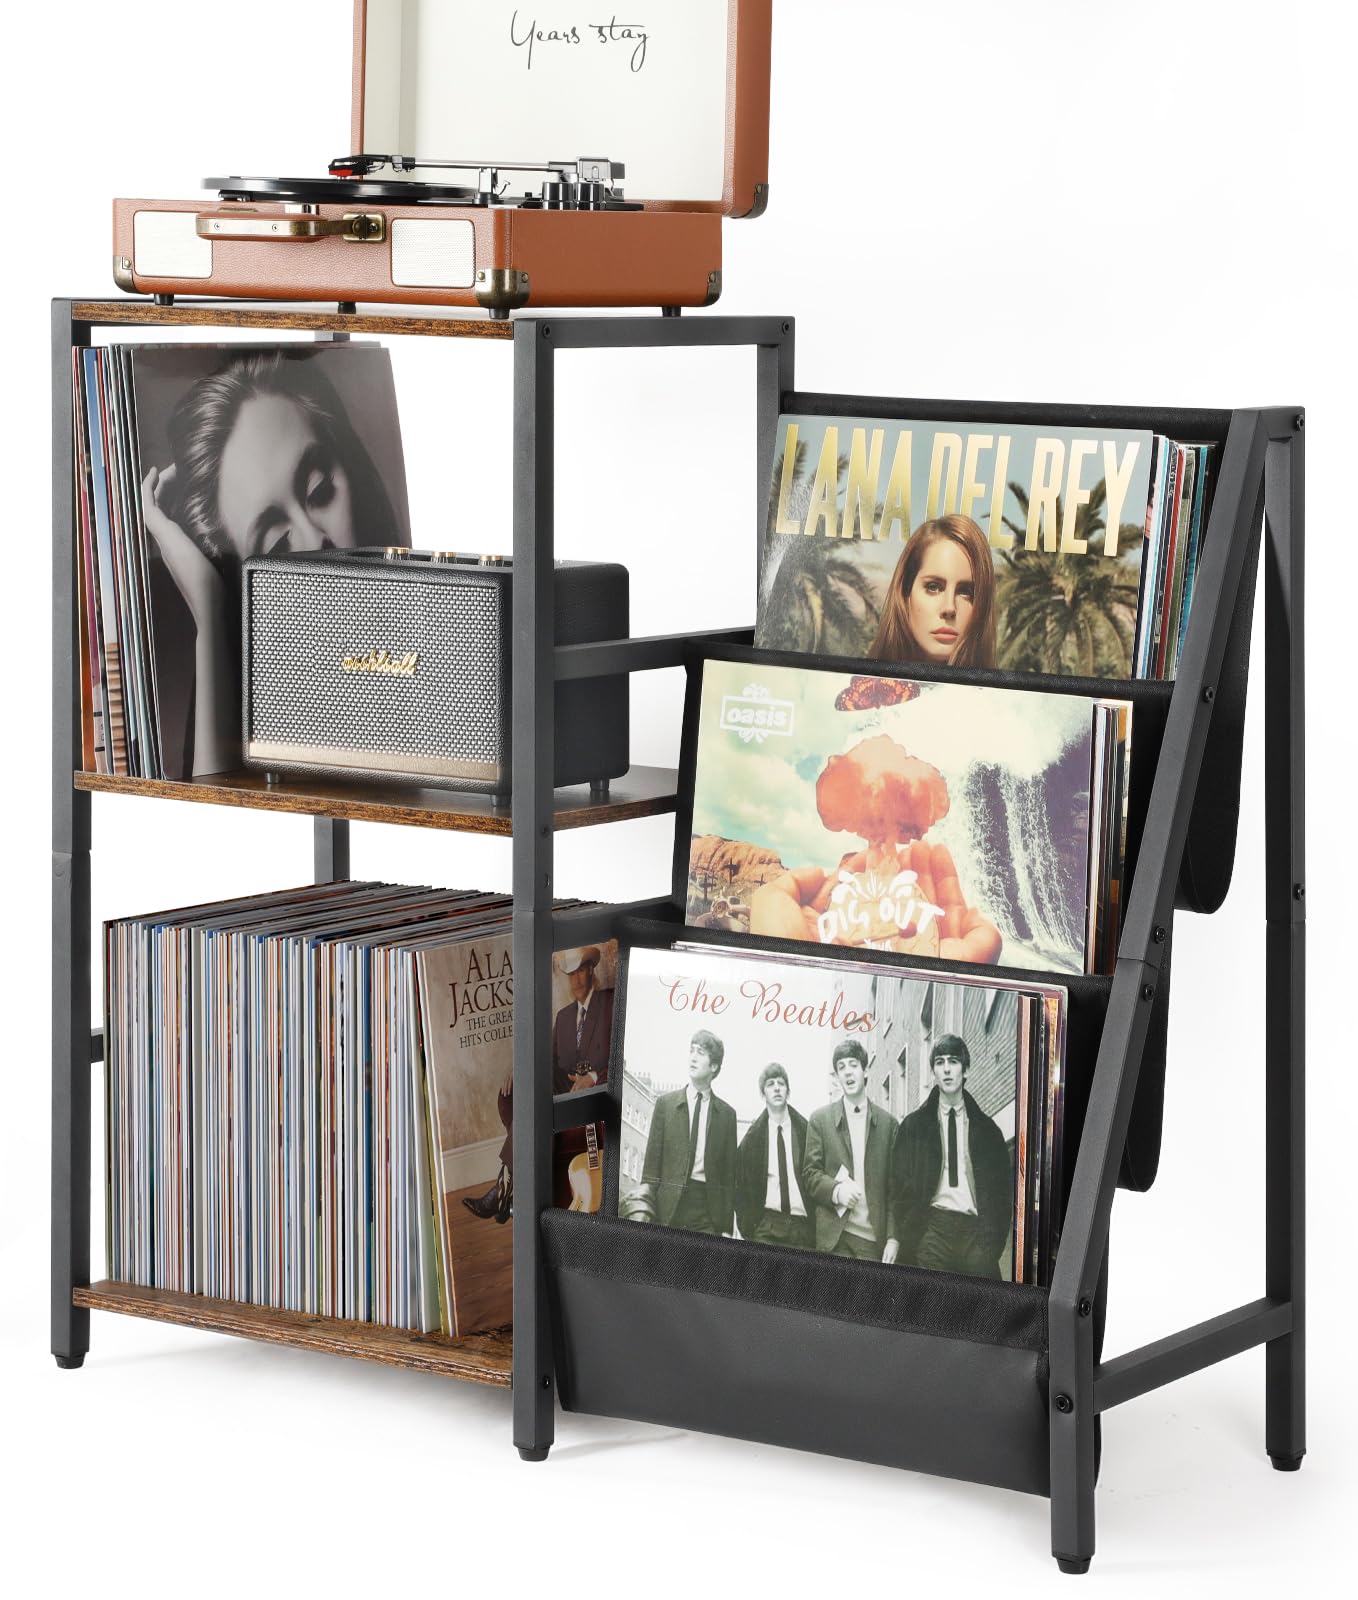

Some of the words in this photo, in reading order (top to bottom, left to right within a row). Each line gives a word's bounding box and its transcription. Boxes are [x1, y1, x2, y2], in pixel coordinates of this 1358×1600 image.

[511, 10, 580, 70] Years
[588, 16, 649, 72] stay
[776, 424, 912, 542] LANA
[1025, 437, 1140, 557] REY
[727, 706, 787, 727] oasis
[817, 899, 871, 944] DIG
[879, 897, 946, 934] OUT
[466, 1014, 487, 1031] THE
[659, 976, 731, 1015] The
[739, 980, 881, 1033] Beatles
[459, 1032, 482, 1049] HITS
